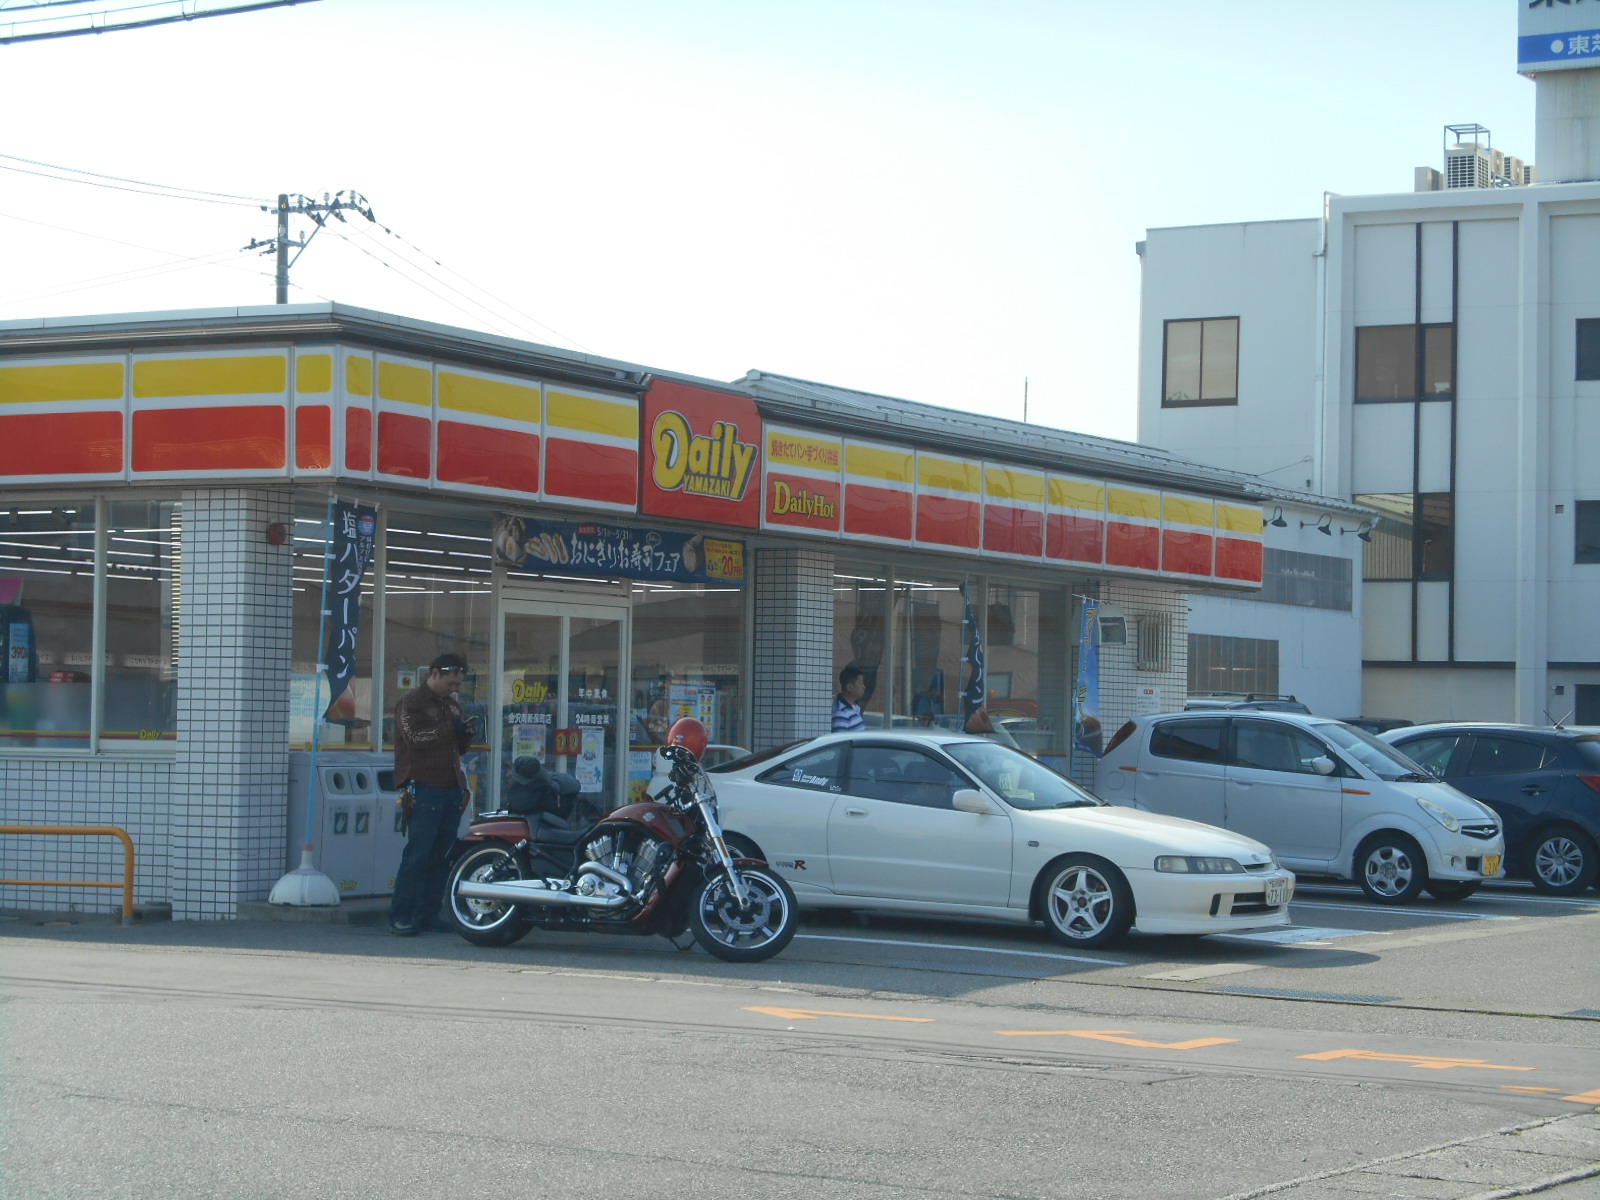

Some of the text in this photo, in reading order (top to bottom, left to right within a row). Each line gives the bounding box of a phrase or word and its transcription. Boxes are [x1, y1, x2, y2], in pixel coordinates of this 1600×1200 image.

[653, 411, 758, 500] Daily
[684, 474, 731, 496] YAMAZAKI
[513, 679, 548, 703] Daily
